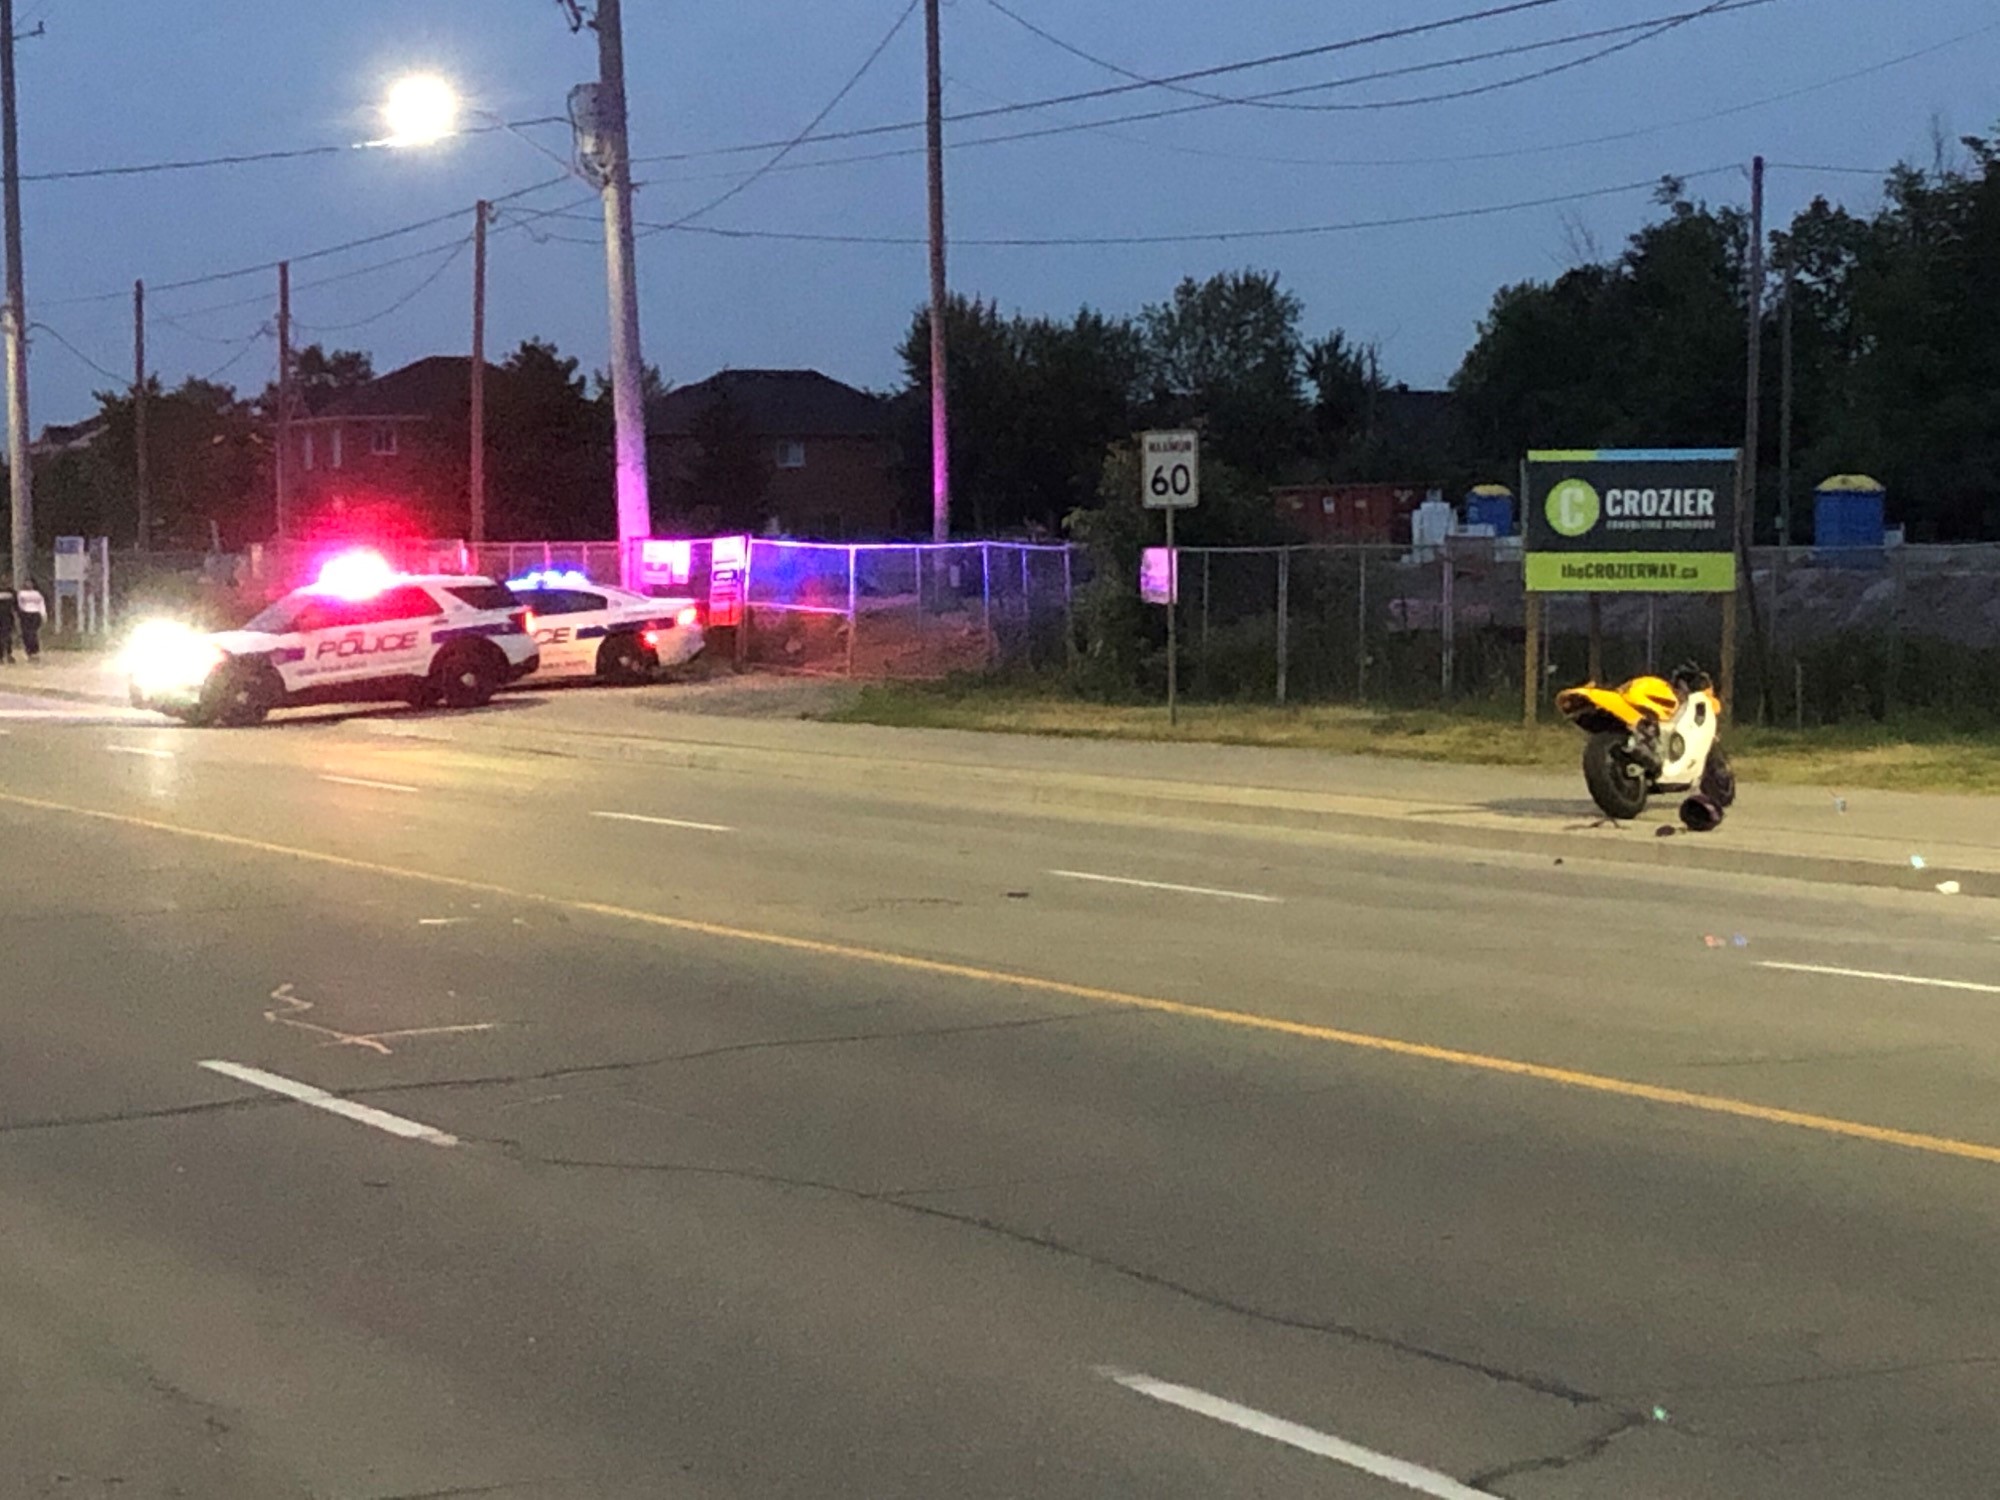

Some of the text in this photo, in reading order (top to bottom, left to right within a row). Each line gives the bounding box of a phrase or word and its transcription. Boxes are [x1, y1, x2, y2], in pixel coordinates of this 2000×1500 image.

[1151, 463, 1190, 496] 60
[1559, 487, 1584, 529] C
[1605, 488, 1714, 517] CROZIER
[1561, 563, 1698, 579] theCROZIERWAY.ca
[315, 631, 419, 660] POLICE
